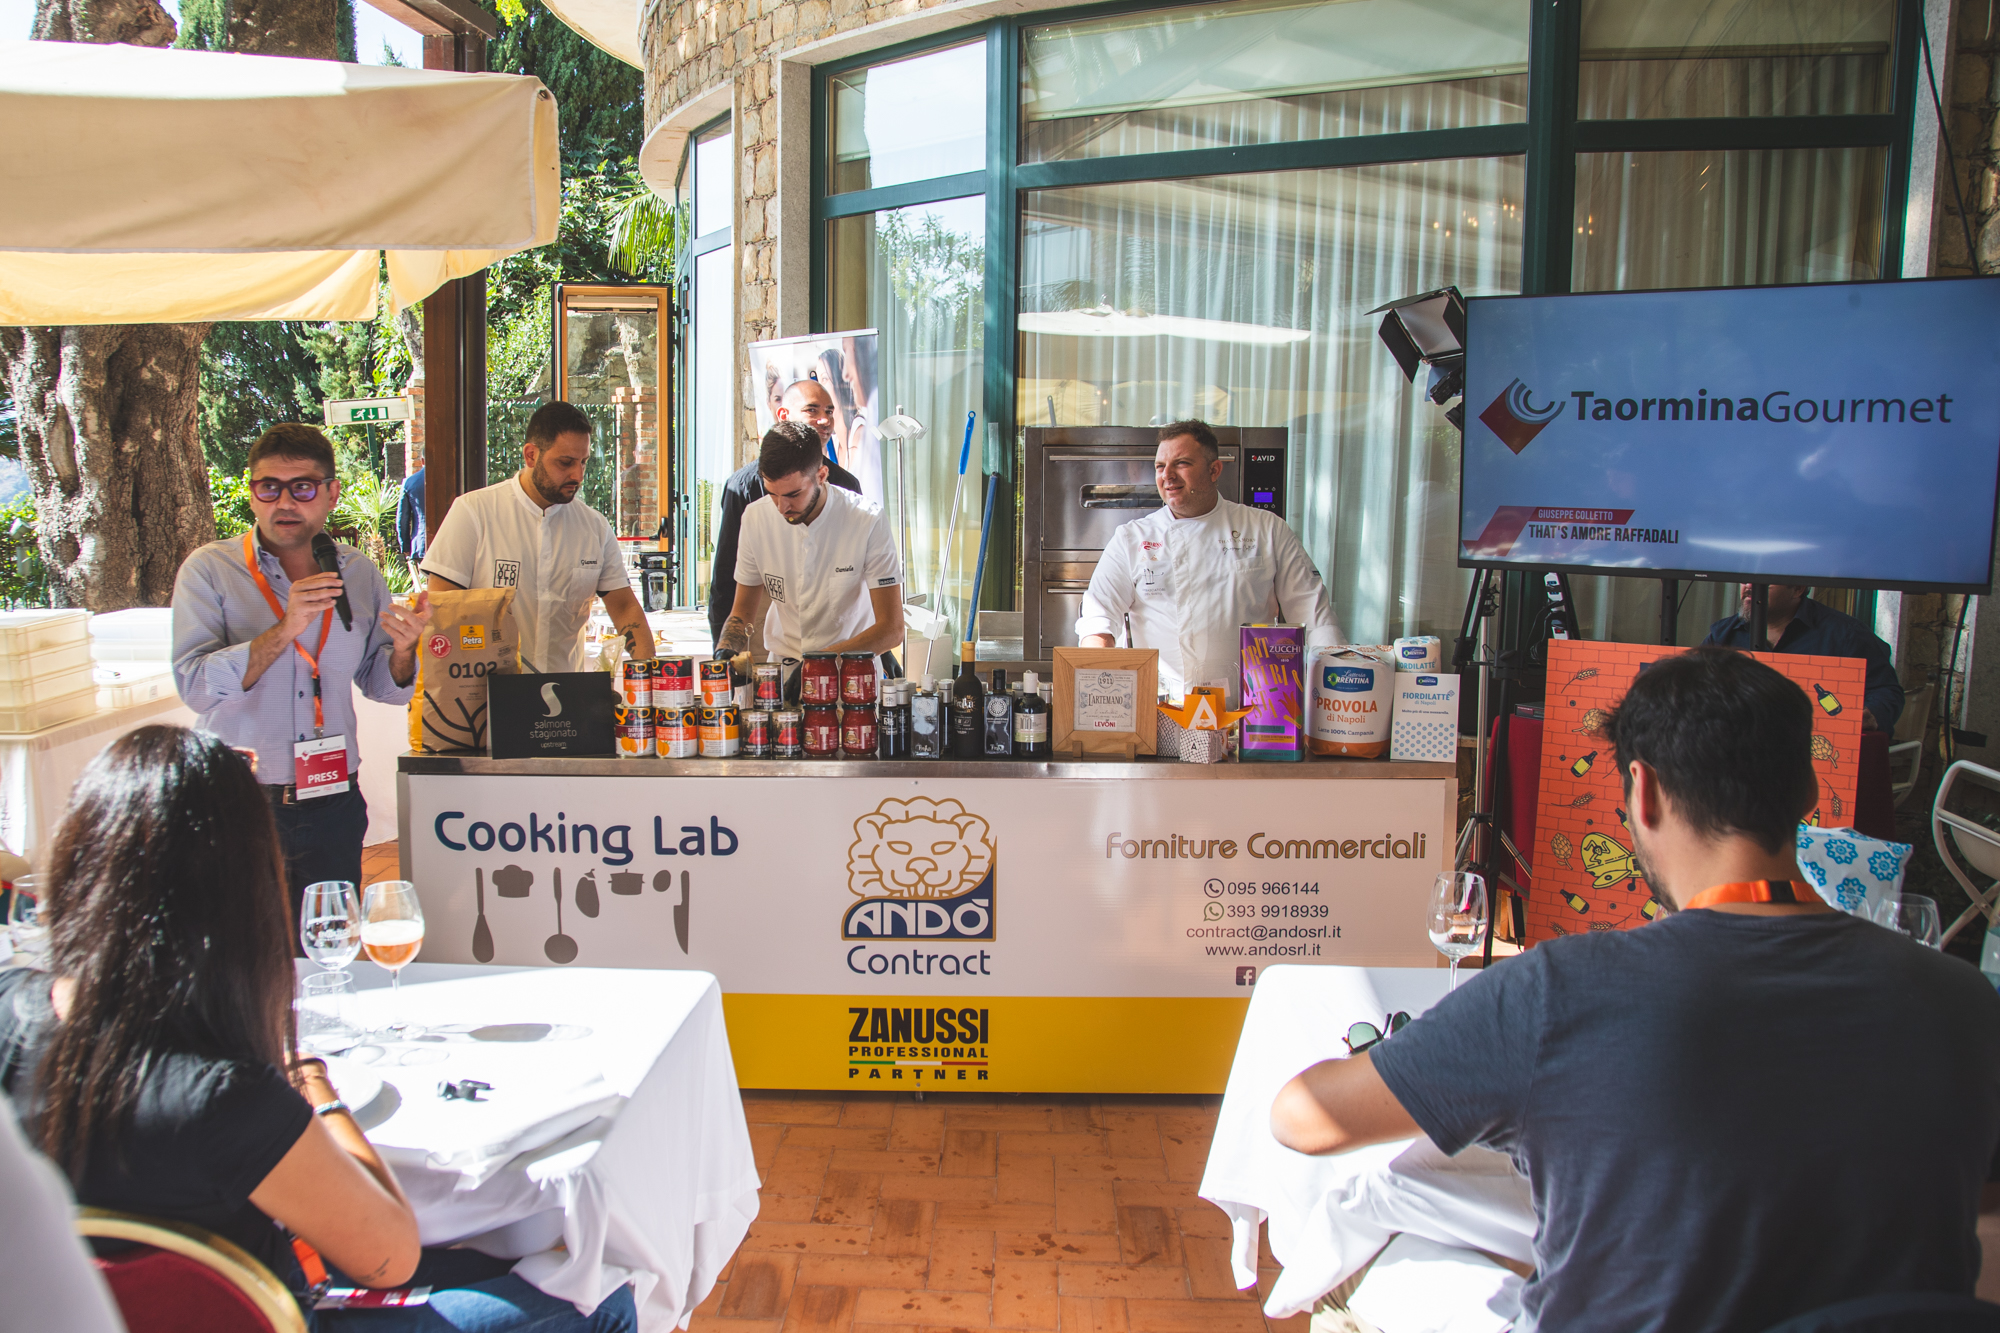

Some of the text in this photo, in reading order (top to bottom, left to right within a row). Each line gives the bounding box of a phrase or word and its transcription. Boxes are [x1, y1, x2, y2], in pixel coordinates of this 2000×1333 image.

[1570, 388, 1953, 424] TaorminaGourmet
[1538, 509, 1613, 521] GIUSEPPE COLLETTO
[1528, 524, 1679, 544] THAT'S AMORE RAFFADALI
[462, 636, 483, 646] Petra
[1269, 645, 1301, 653] ZUCCHI
[448, 661, 498, 679] 0102
[1402, 692, 1450, 701] FIORDILATTE
[1316, 696, 1378, 713] PROVOLA
[534, 720, 571, 729] salmone
[1326, 713, 1366, 725] di Napoli
[529, 728, 578, 740] stagionato
[1317, 726, 1330, 734] Latte
[540, 741, 567, 749] upstream
[307, 770, 339, 785] PRESS
[434, 811, 739, 866] Cooking Lab
[1106, 832, 1427, 859] Forniture Commerciali
[1227, 882, 1320, 896] 095 966144
[1226, 905, 1329, 918] 393 9918939
[1186, 925, 1341, 941] contract@andosrl.it
[1205, 943, 1321, 957] www.andosrl.it
[847, 945, 991, 975] Contract
[848, 1007, 989, 1044] ZANUSSI
[848, 1046, 989, 1058] PROFESSIONAL
[848, 1068, 989, 1081] PARTNER
